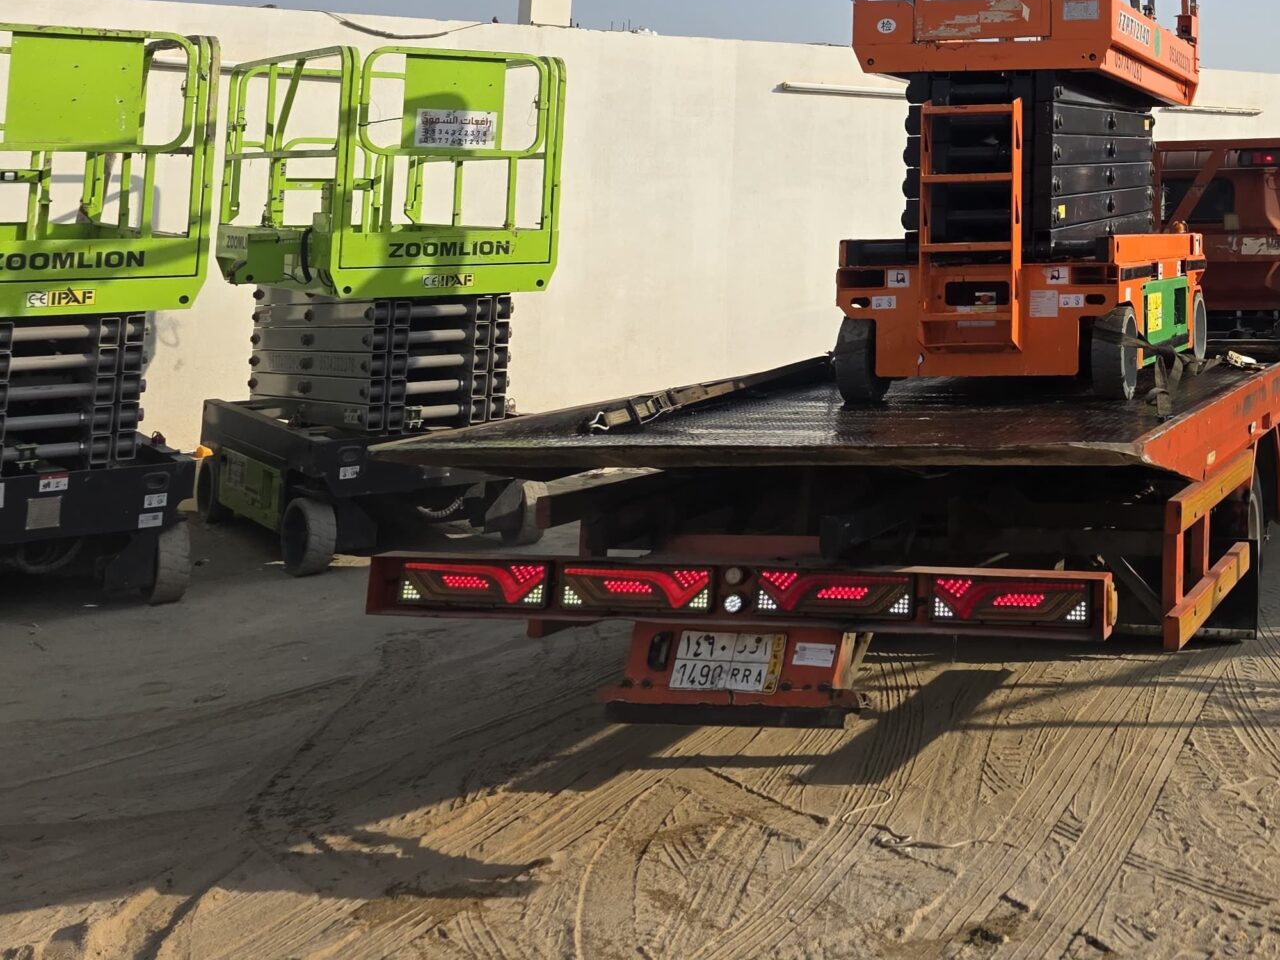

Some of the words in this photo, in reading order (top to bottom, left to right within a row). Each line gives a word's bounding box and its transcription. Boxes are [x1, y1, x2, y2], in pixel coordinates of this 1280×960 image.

[461, 116, 493, 128] رافعات
[388, 241, 511, 258] ZOOMLION
[0, 251, 146, 271] OOMLION
[440, 274, 473, 287] IPAF
[51, 287, 93, 306] IPAF
[677, 663, 724, 686] 1490
[730, 668, 763, 686] RRA
